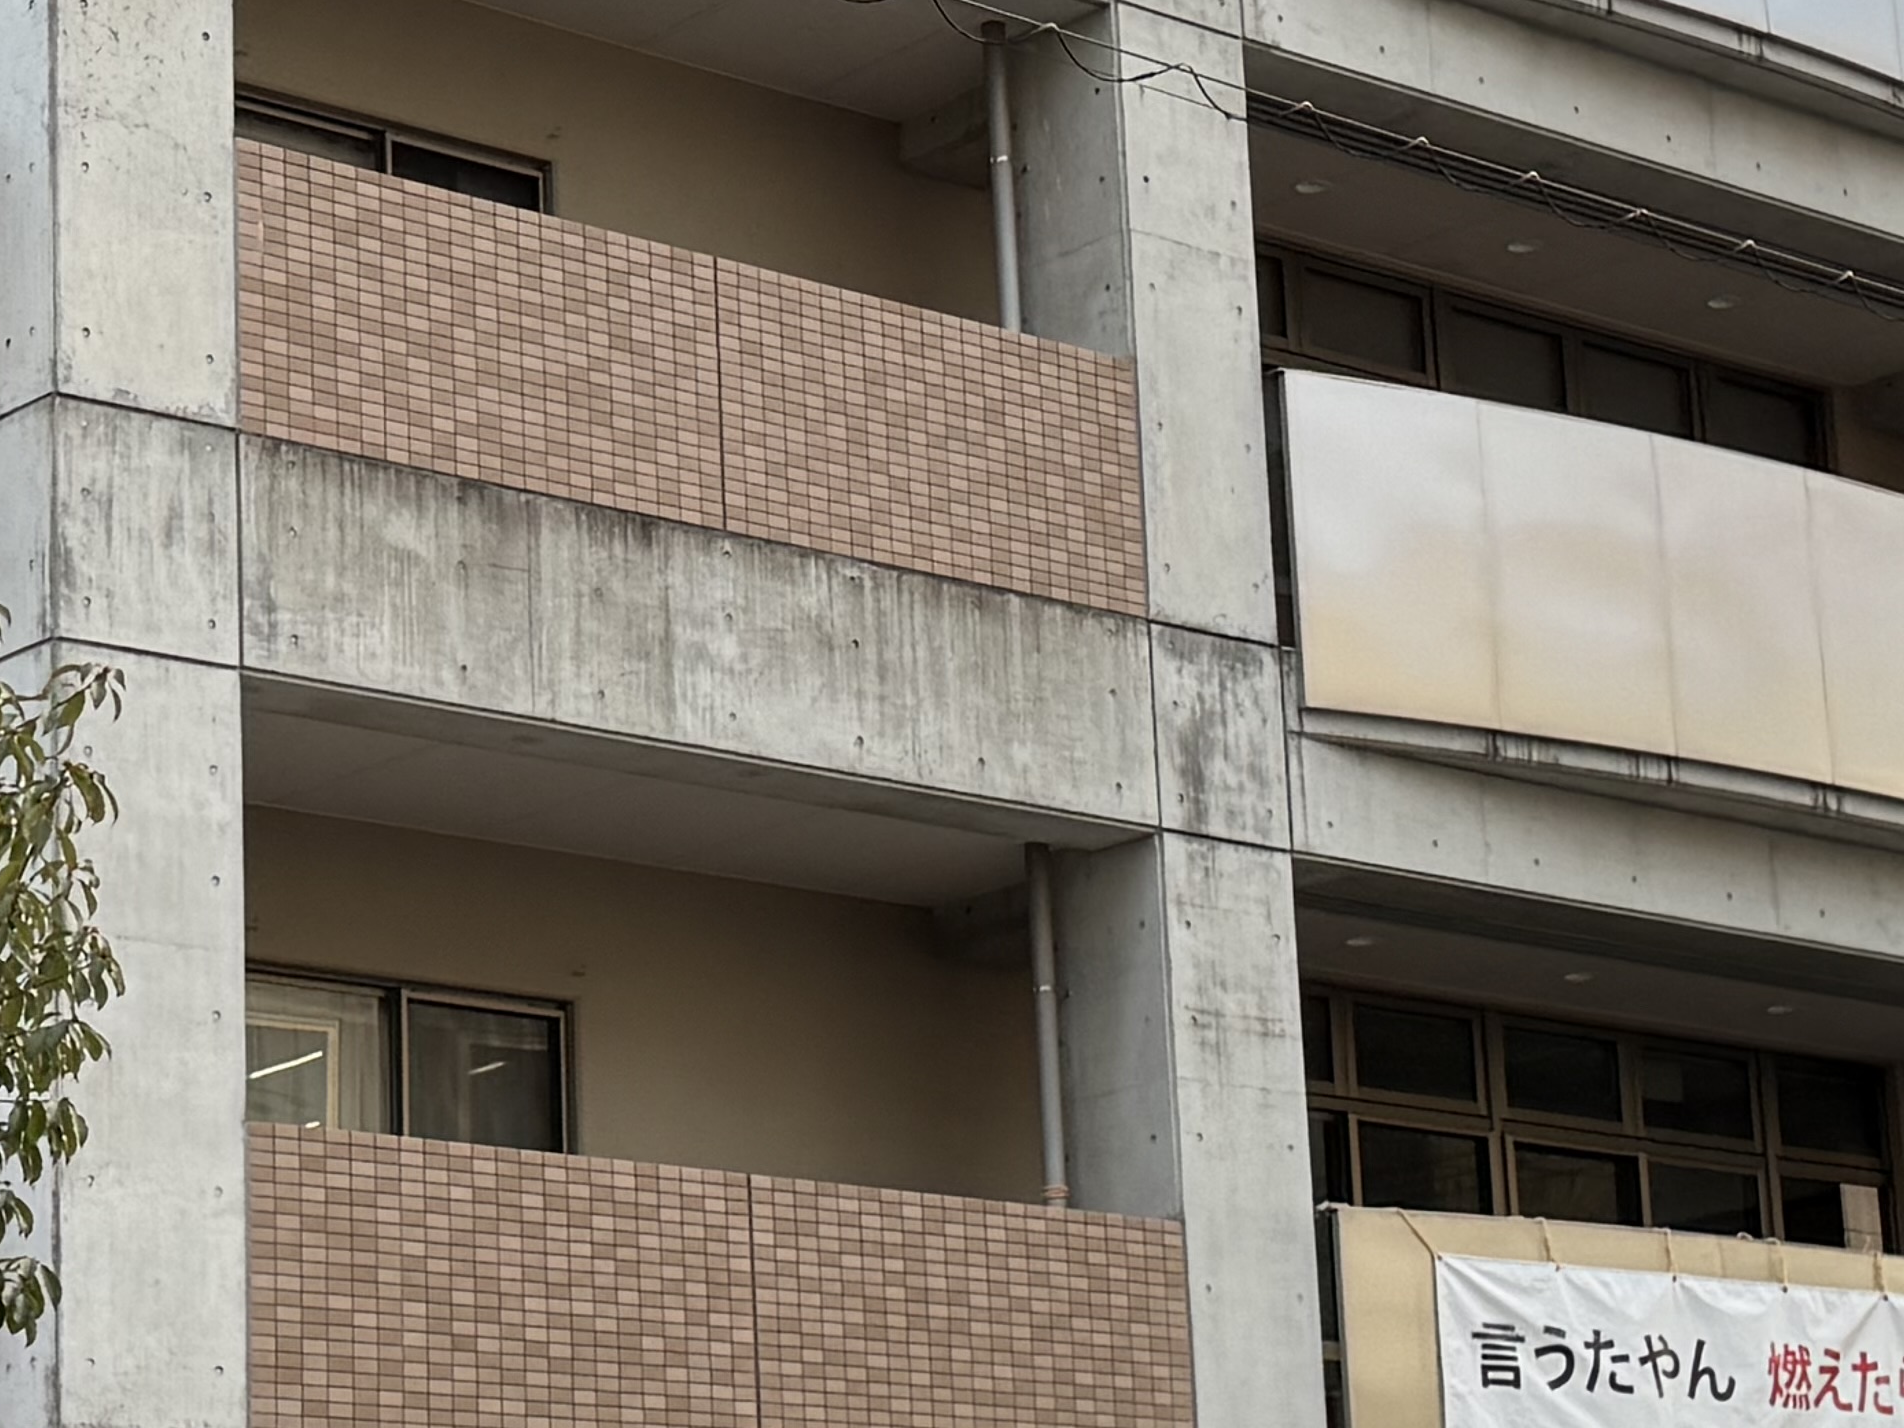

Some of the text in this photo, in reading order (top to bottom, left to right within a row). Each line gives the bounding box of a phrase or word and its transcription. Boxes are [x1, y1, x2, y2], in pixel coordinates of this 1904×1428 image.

[1471, 1322, 1736, 1402] 言うたやん
